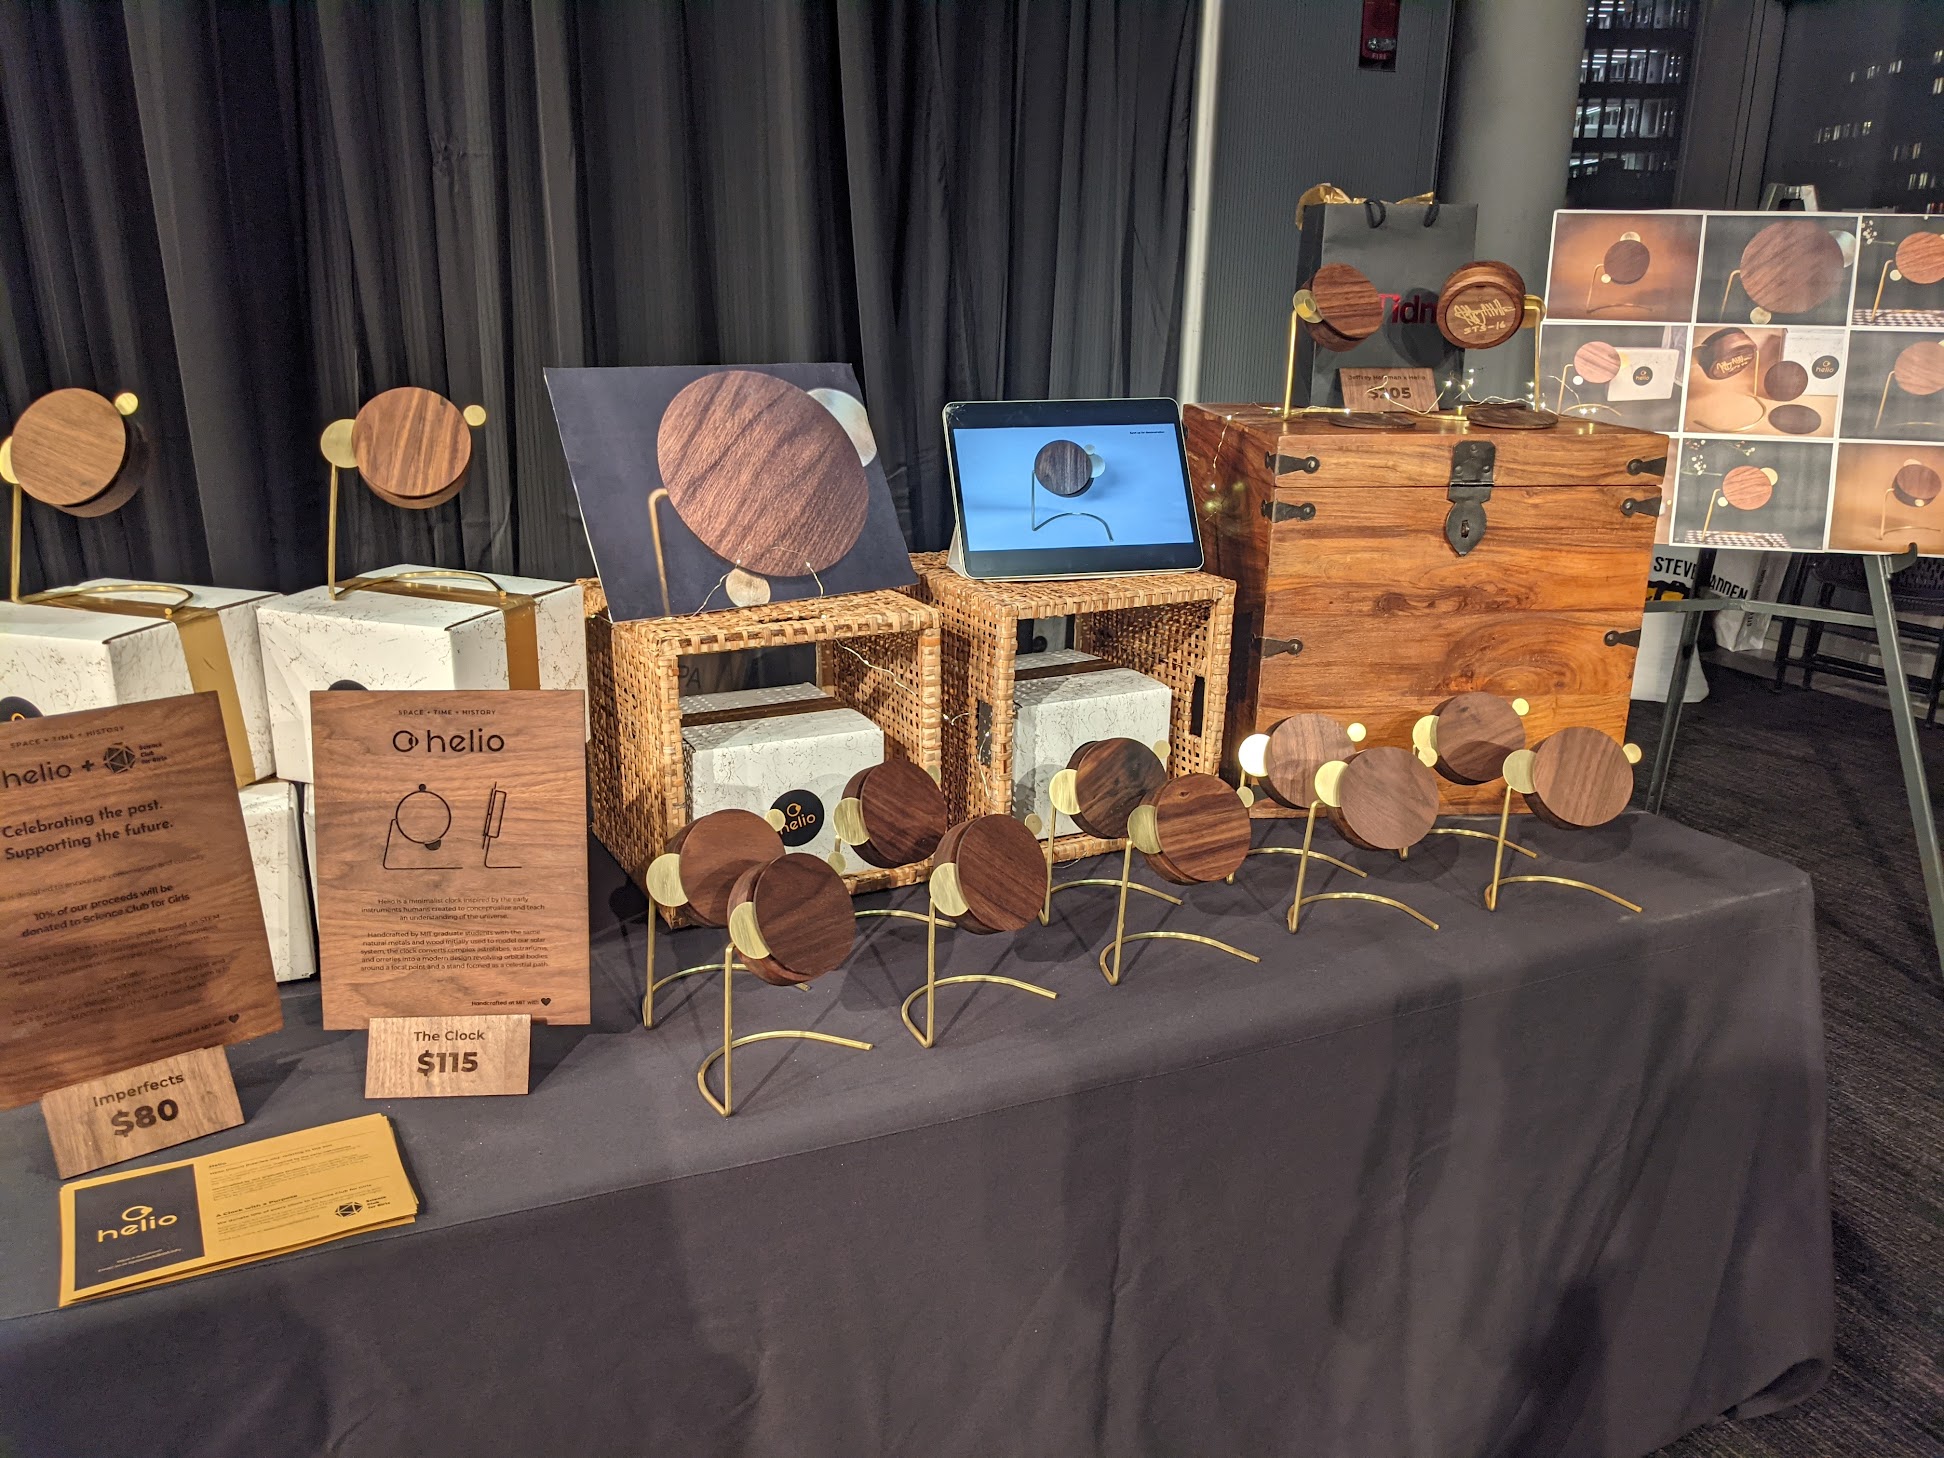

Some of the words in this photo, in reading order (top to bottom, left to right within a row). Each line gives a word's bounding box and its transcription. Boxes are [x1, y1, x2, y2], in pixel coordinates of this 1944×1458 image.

[10, 738, 41, 748] SPACE
[86, 726, 125, 737] HISTORY
[427, 728, 504, 752] helio
[2, 761, 72, 788] helio
[82, 760, 94, 772] +
[2, 814, 94, 838] Celebrating
[99, 806, 122, 820] the
[128, 800, 163, 818] past.
[5, 836, 92, 860] Supporting
[96, 828, 120, 842] the
[125, 820, 174, 836] future.
[22, 920, 68, 938] donated
[70, 918, 81, 927] to
[83, 908, 126, 924] Science
[126, 902, 149, 914] Club
[150, 899, 166, 908] for
[168, 893, 190, 904] Girls
[34, 910, 55, 920] 10%
[57, 906, 68, 916] of
[70, 903, 88, 913] our
[90, 892, 138, 911] proceeds
[140, 886, 158, 898] will
[160, 885, 173, 893] be
[414, 1031, 440, 1042] The
[444, 1030, 486, 1041] Clock
[416, 1050, 478, 1076] $115
[92, 1074, 184, 1108] Imperfects
[110, 1098, 178, 1138] $80
[98, 1214, 178, 1242] helio
